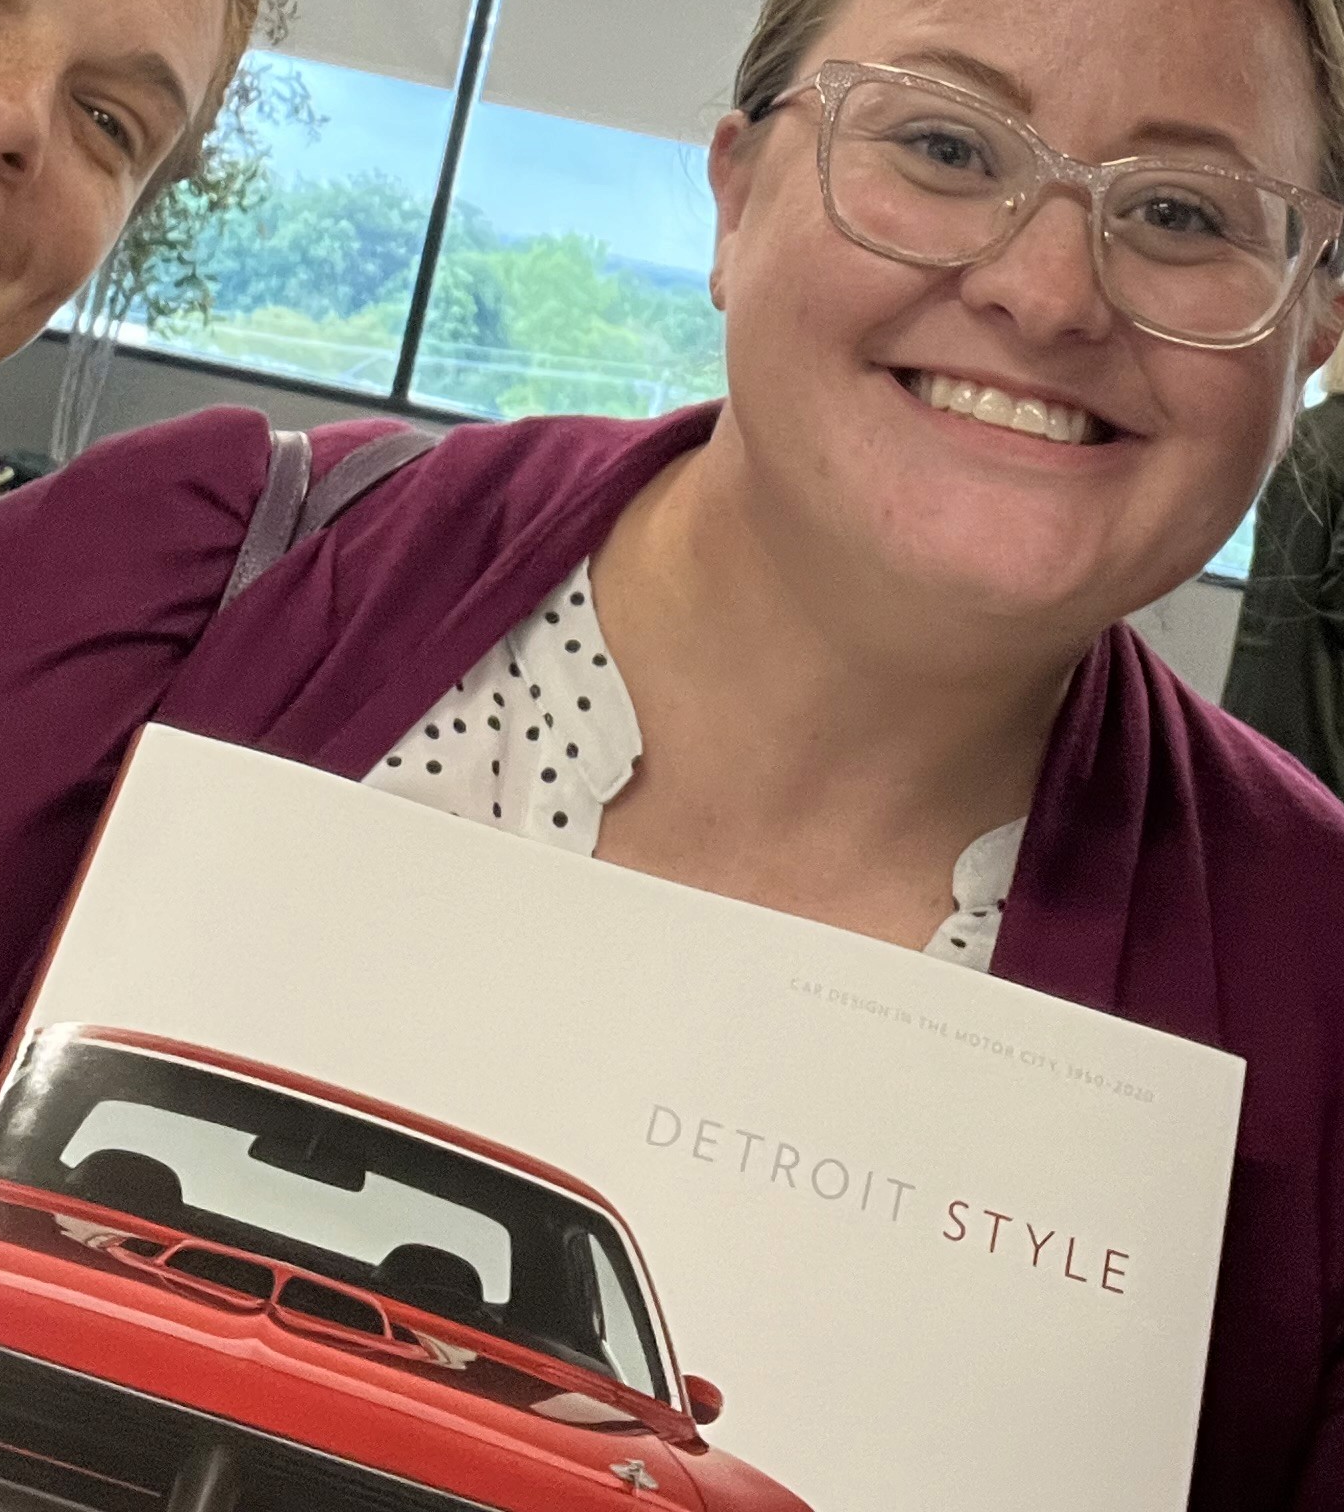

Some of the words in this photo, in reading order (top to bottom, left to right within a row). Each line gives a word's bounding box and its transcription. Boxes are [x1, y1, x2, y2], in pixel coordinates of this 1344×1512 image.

[790, 977, 823, 999] CAR
[828, 988, 891, 1017] DESIGN
[895, 1008, 913, 1025] IN
[919, 1015, 948, 1038] THE
[954, 1029, 1014, 1058] MOTOR
[645, 1104, 916, 1222] DETROIT
[942, 1200, 1130, 1294] STYLE
